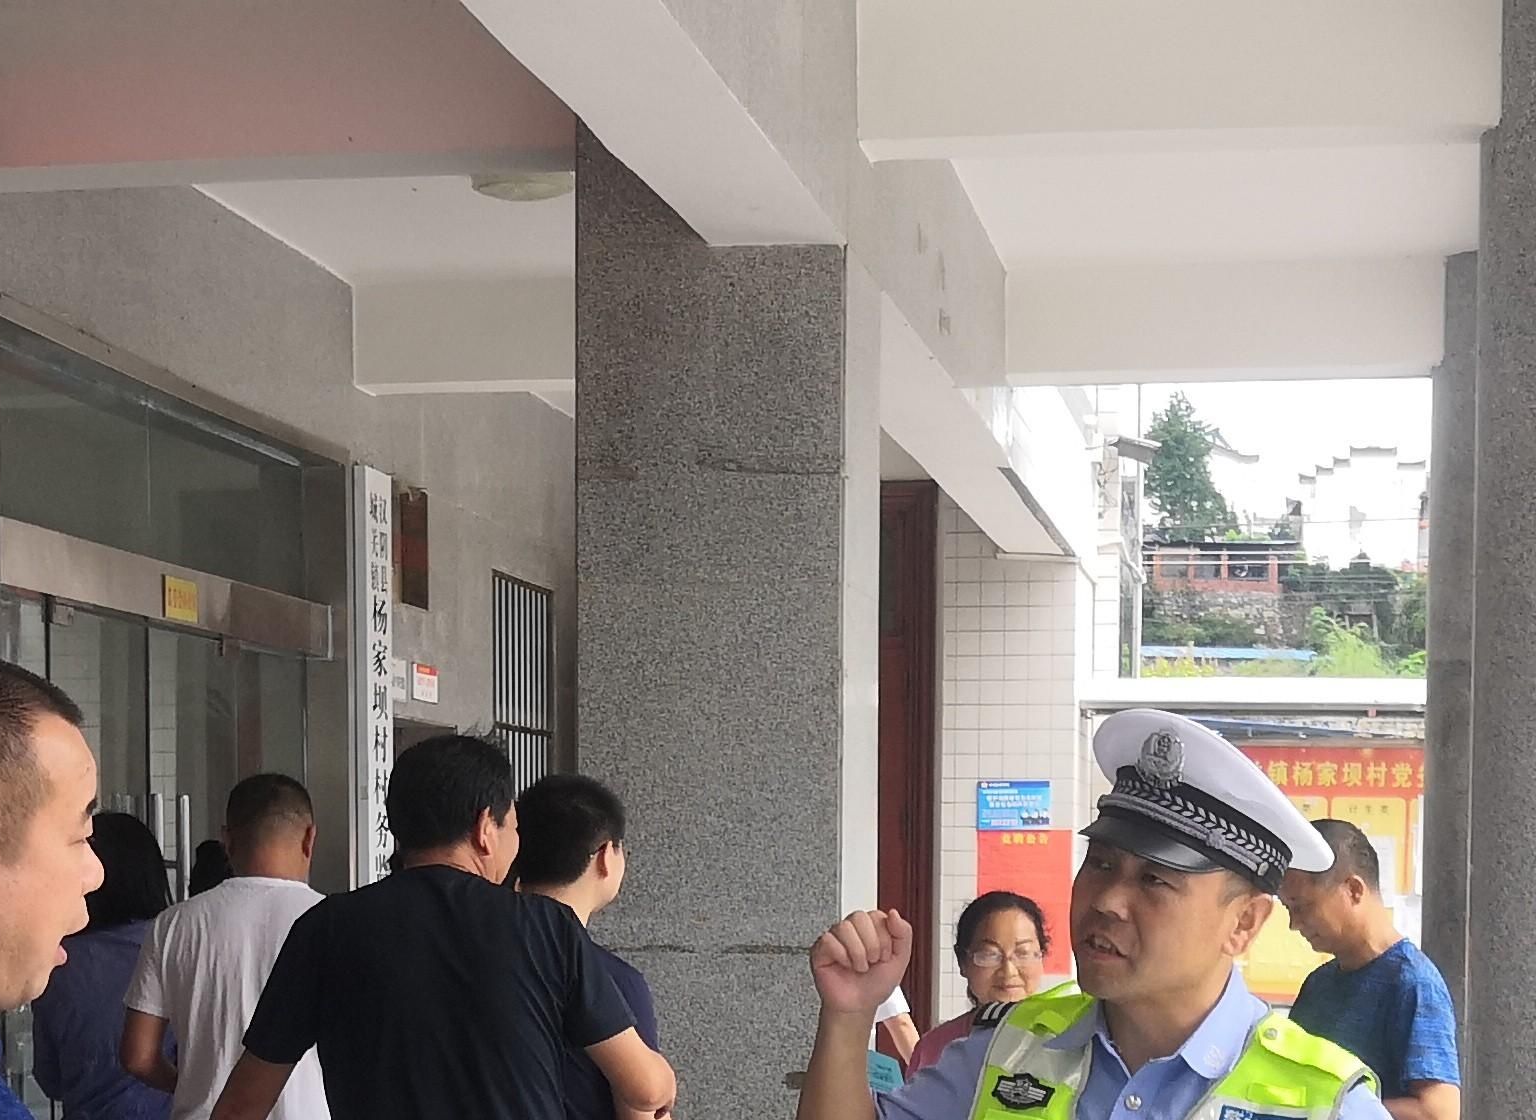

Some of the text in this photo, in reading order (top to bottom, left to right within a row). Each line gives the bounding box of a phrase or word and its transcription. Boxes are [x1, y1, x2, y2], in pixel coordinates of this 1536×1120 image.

[1256, 760, 1425, 788] 镇杨家坝村党
